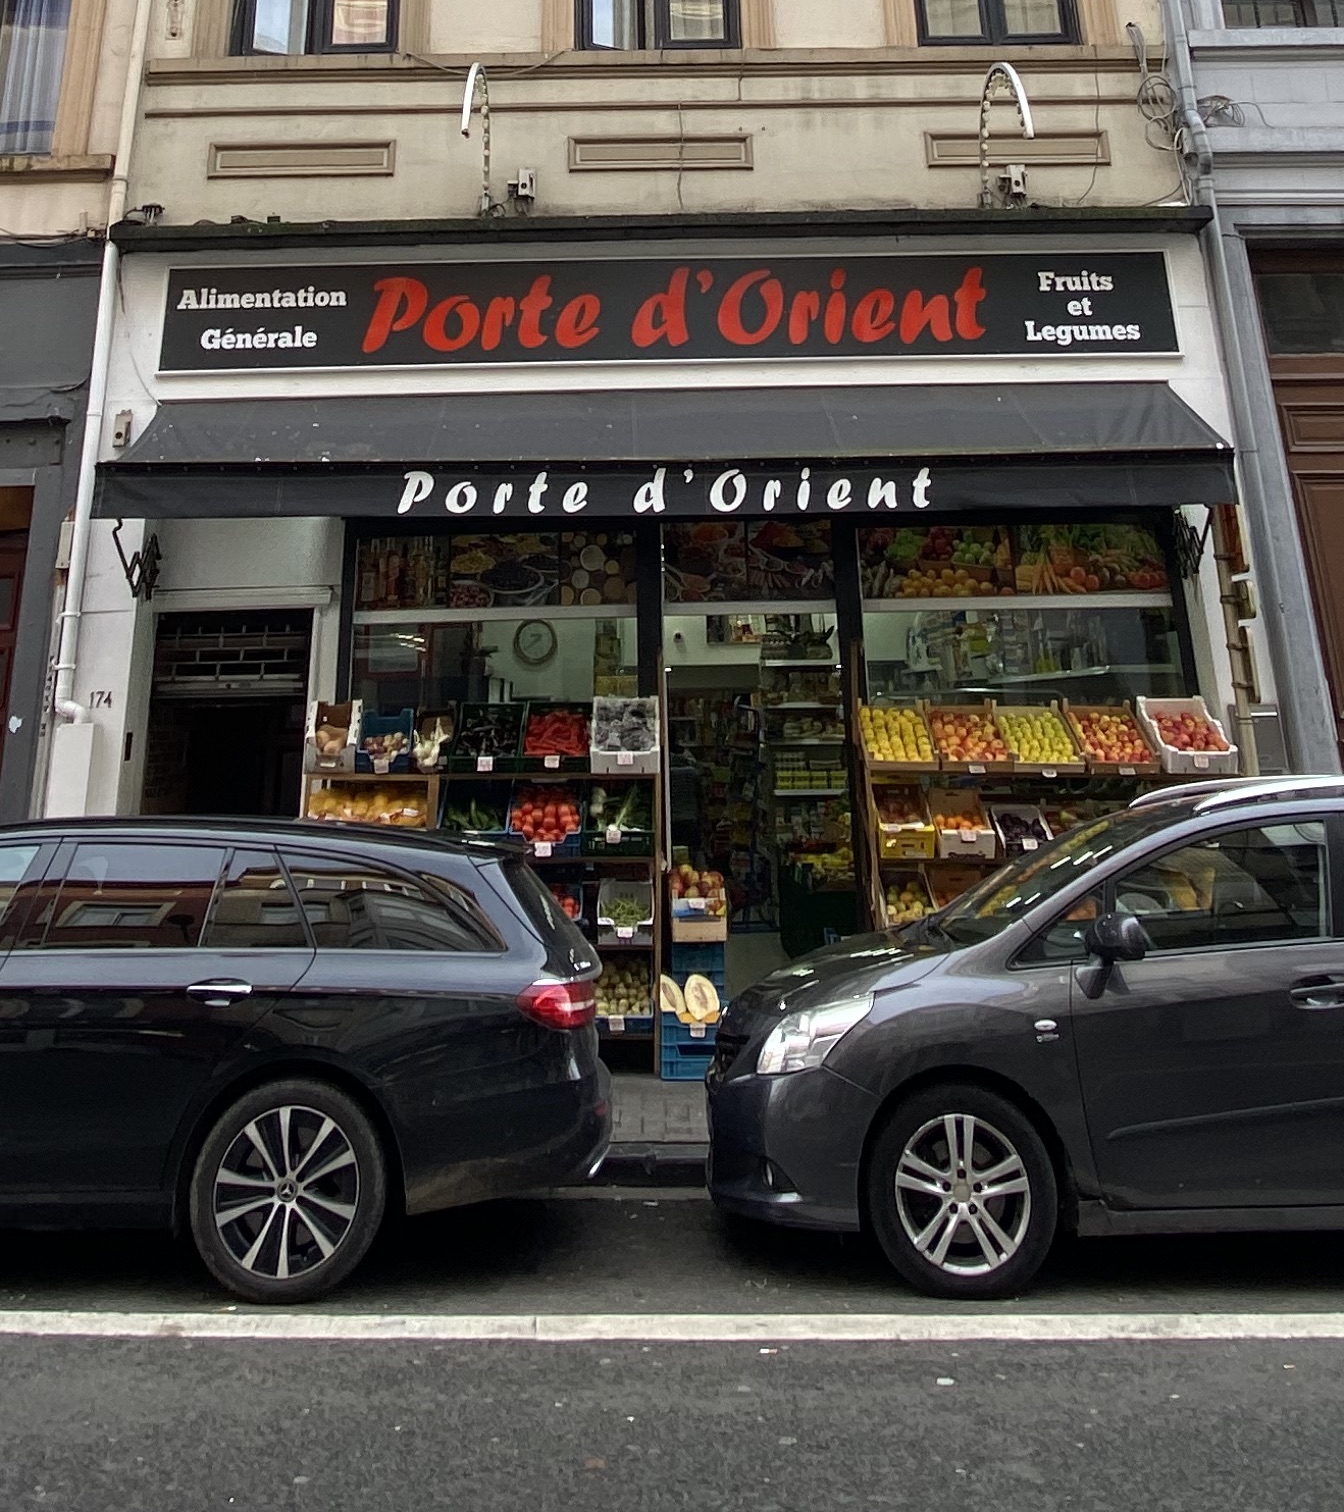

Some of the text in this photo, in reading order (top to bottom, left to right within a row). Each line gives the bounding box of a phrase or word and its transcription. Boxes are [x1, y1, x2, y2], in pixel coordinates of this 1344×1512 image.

[1038, 270, 1114, 293] Fruits
[176, 286, 347, 310] Alimentation
[361, 266, 987, 354] Porte d'Orient
[1066, 295, 1094, 317] et
[200, 326, 317, 350] Générale
[1024, 320, 1141, 347] Legumes
[397, 467, 932, 515] Porte d'Orient
[89, 691, 112, 709] 174
